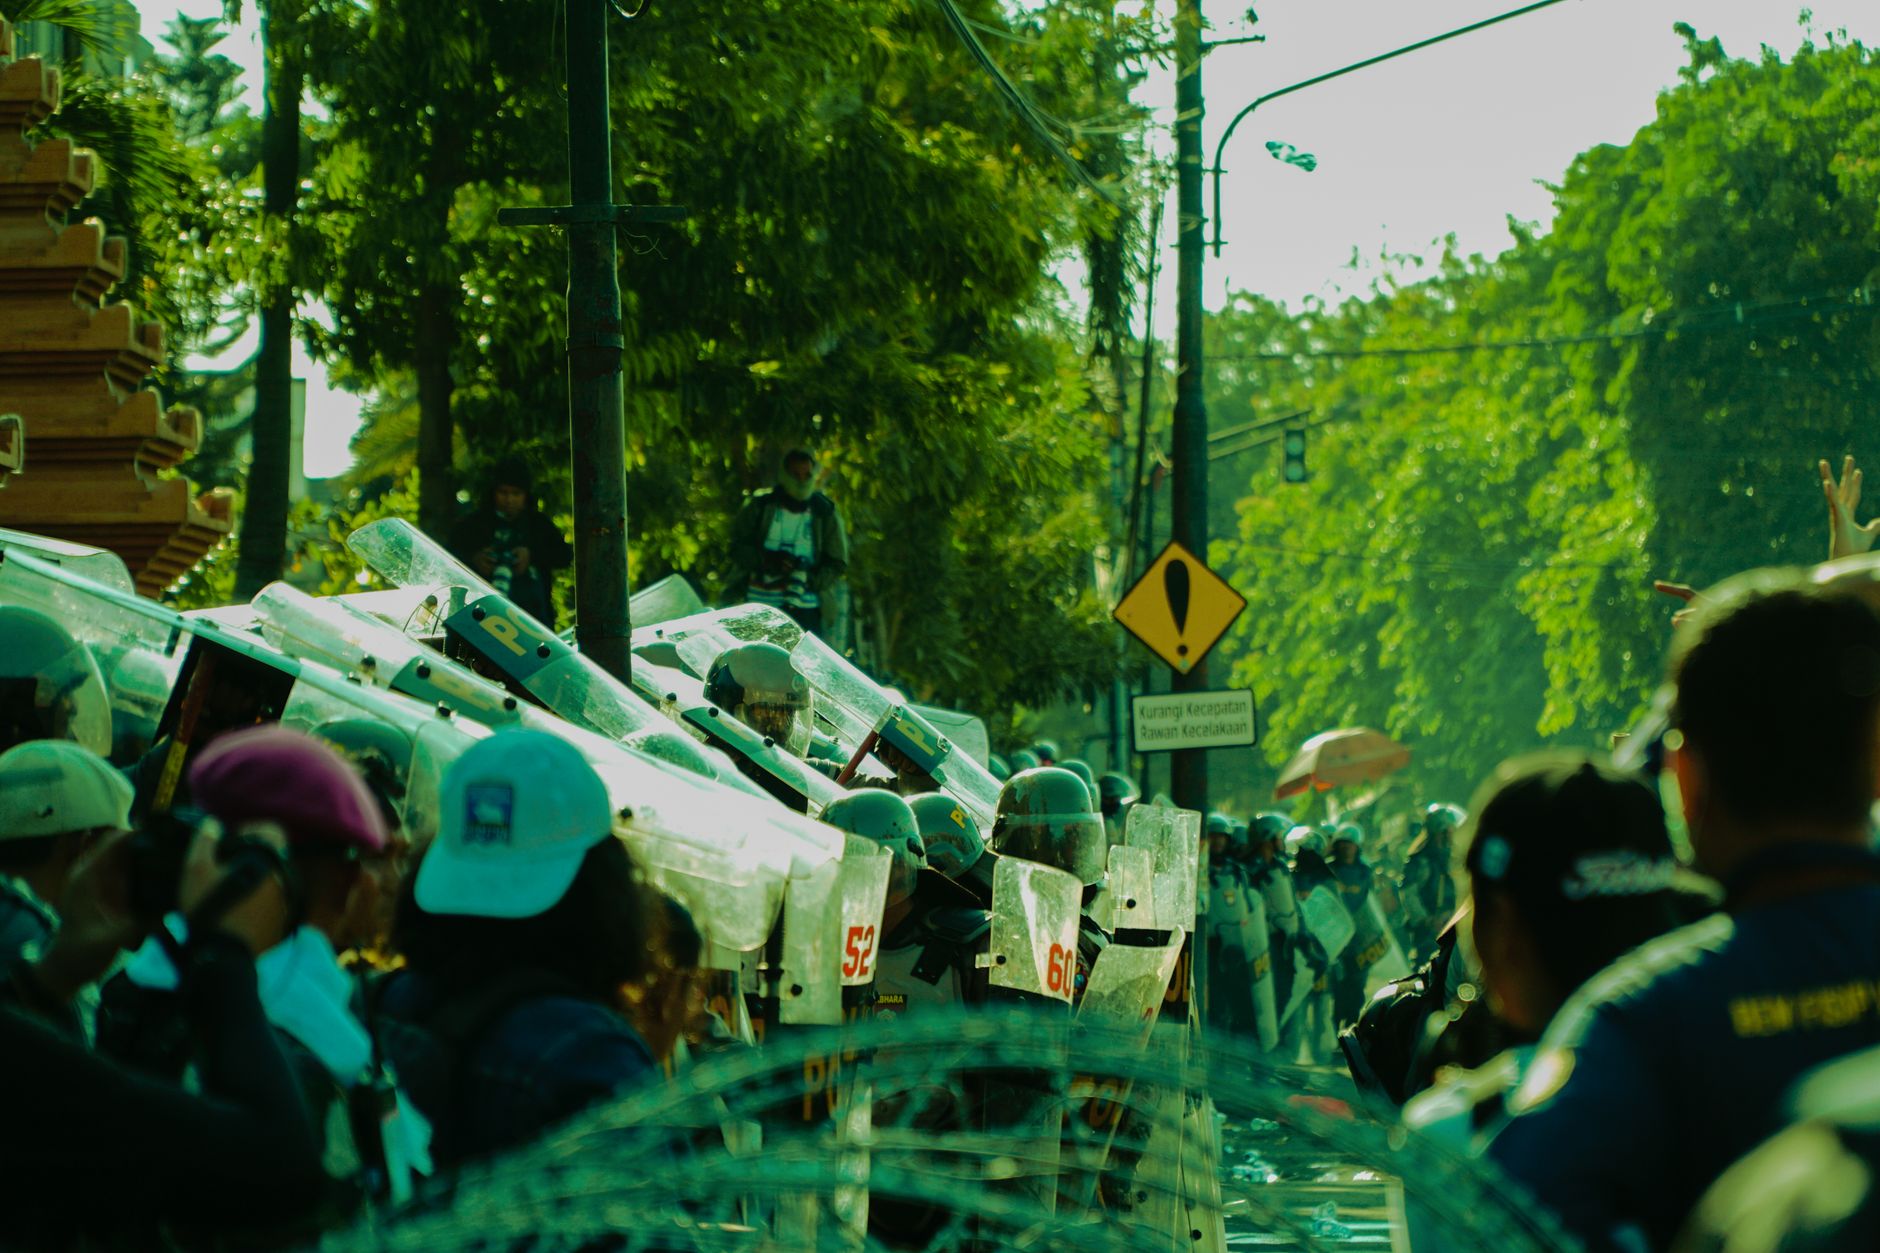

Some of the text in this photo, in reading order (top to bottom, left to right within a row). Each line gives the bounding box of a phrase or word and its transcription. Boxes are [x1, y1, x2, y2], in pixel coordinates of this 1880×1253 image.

[1140, 701, 1247, 721] Kurangi Kecepatan
[1140, 721, 1247, 739] Rawan Kecelakaan
[842, 925, 875, 978] 52
[1047, 943, 1074, 998] 60
[877, 995, 904, 1004] BHARA
